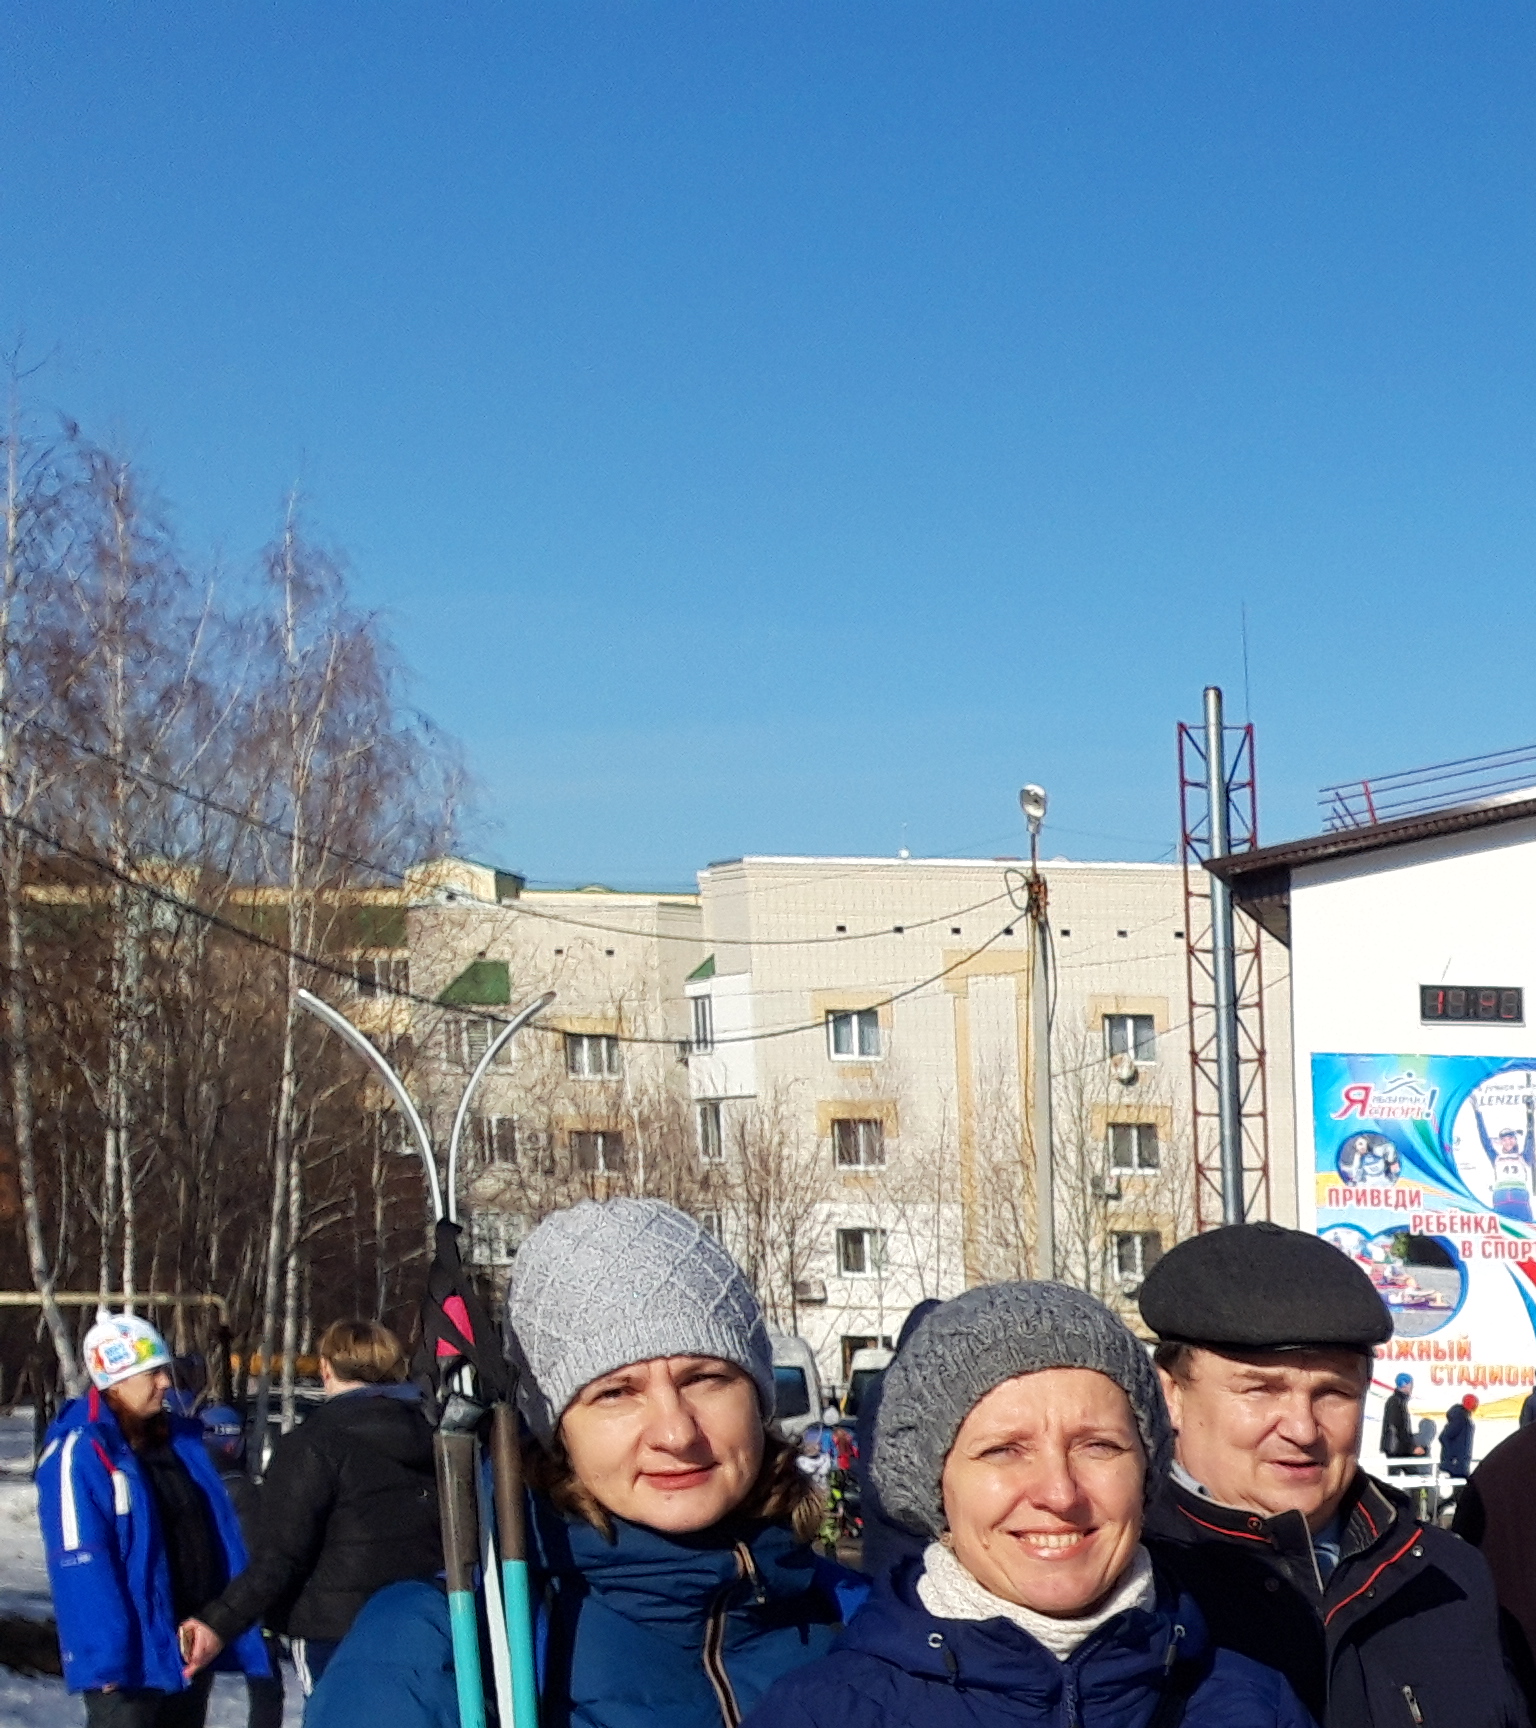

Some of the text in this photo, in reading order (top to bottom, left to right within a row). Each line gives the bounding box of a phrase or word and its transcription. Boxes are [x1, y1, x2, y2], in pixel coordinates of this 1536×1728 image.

[1327, 1186, 1422, 1208] ПРИВЕДИ
[1410, 1211, 1500, 1235] РЕБЁНКА
[1461, 1240, 1474, 1257] В
[1374, 1334, 1471, 1362] ЫЖНЫЙ
[1430, 1364, 1534, 1387] СТАДИОН
